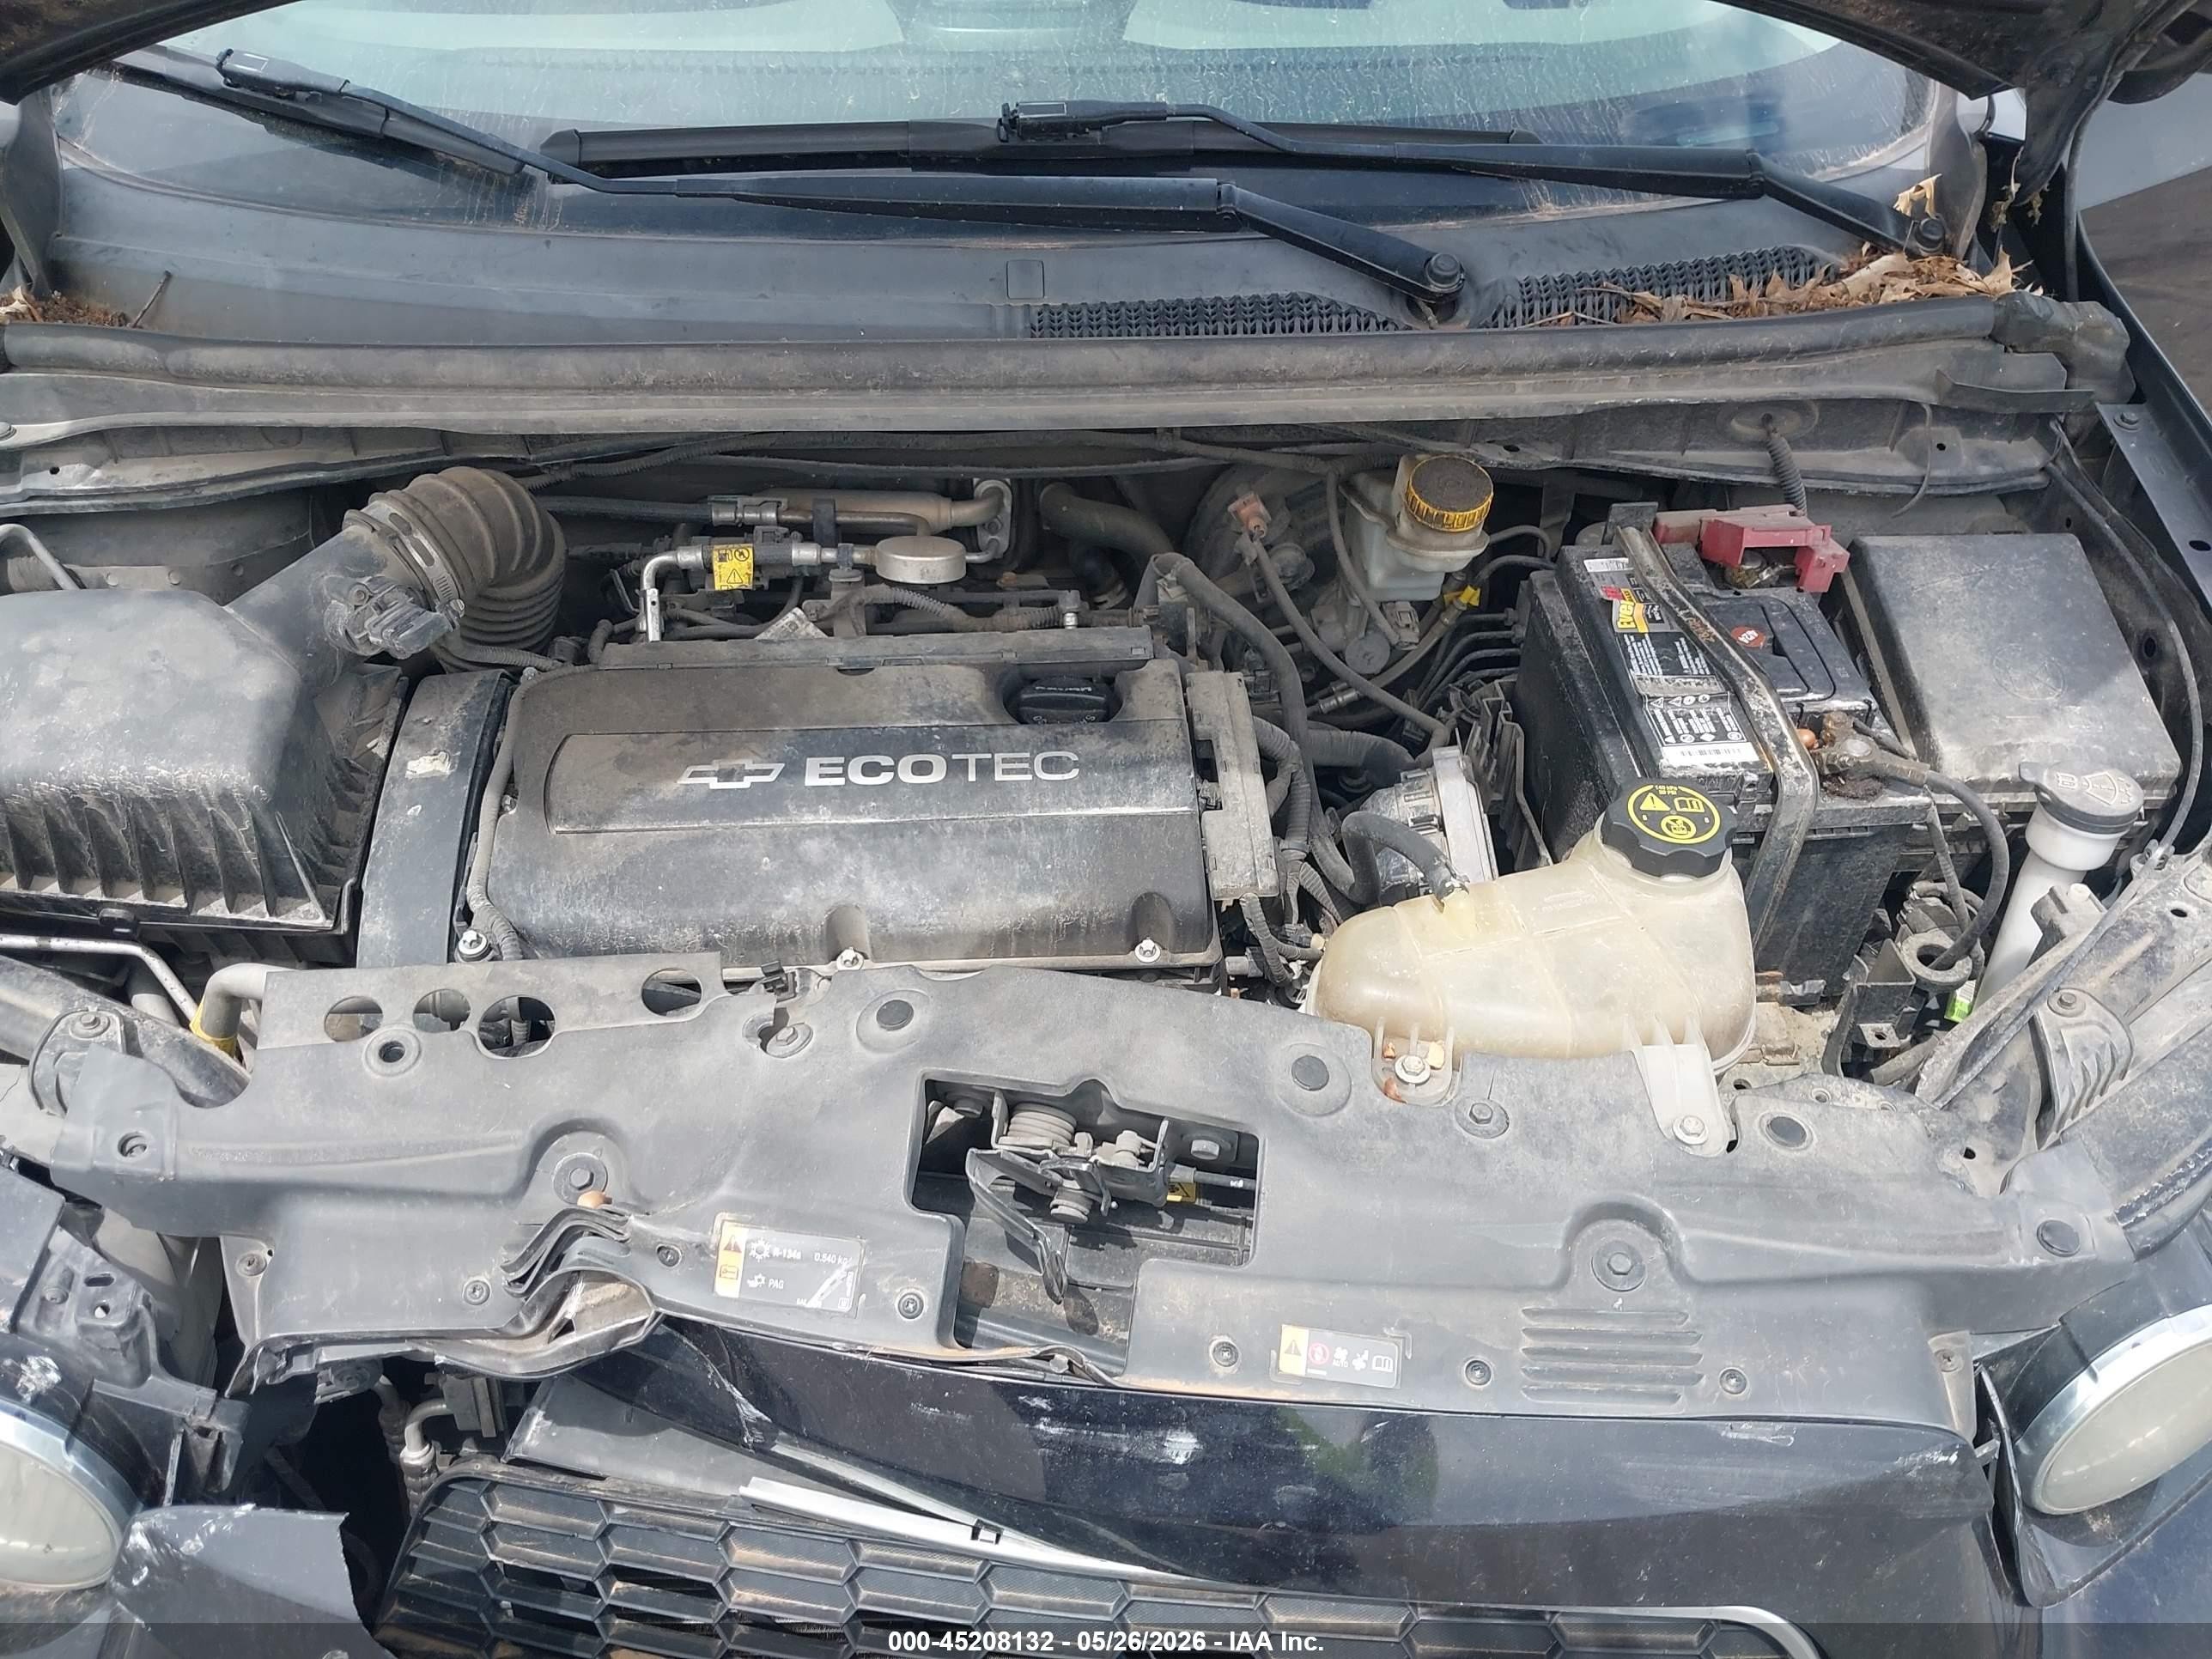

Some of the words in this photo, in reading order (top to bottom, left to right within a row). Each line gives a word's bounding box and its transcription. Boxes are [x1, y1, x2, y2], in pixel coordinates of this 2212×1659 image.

[804, 750, 1079, 787] ECOTEC
[768, 1279, 784, 1290] PAG
[1332, 1358, 1349, 1368] AUTO
